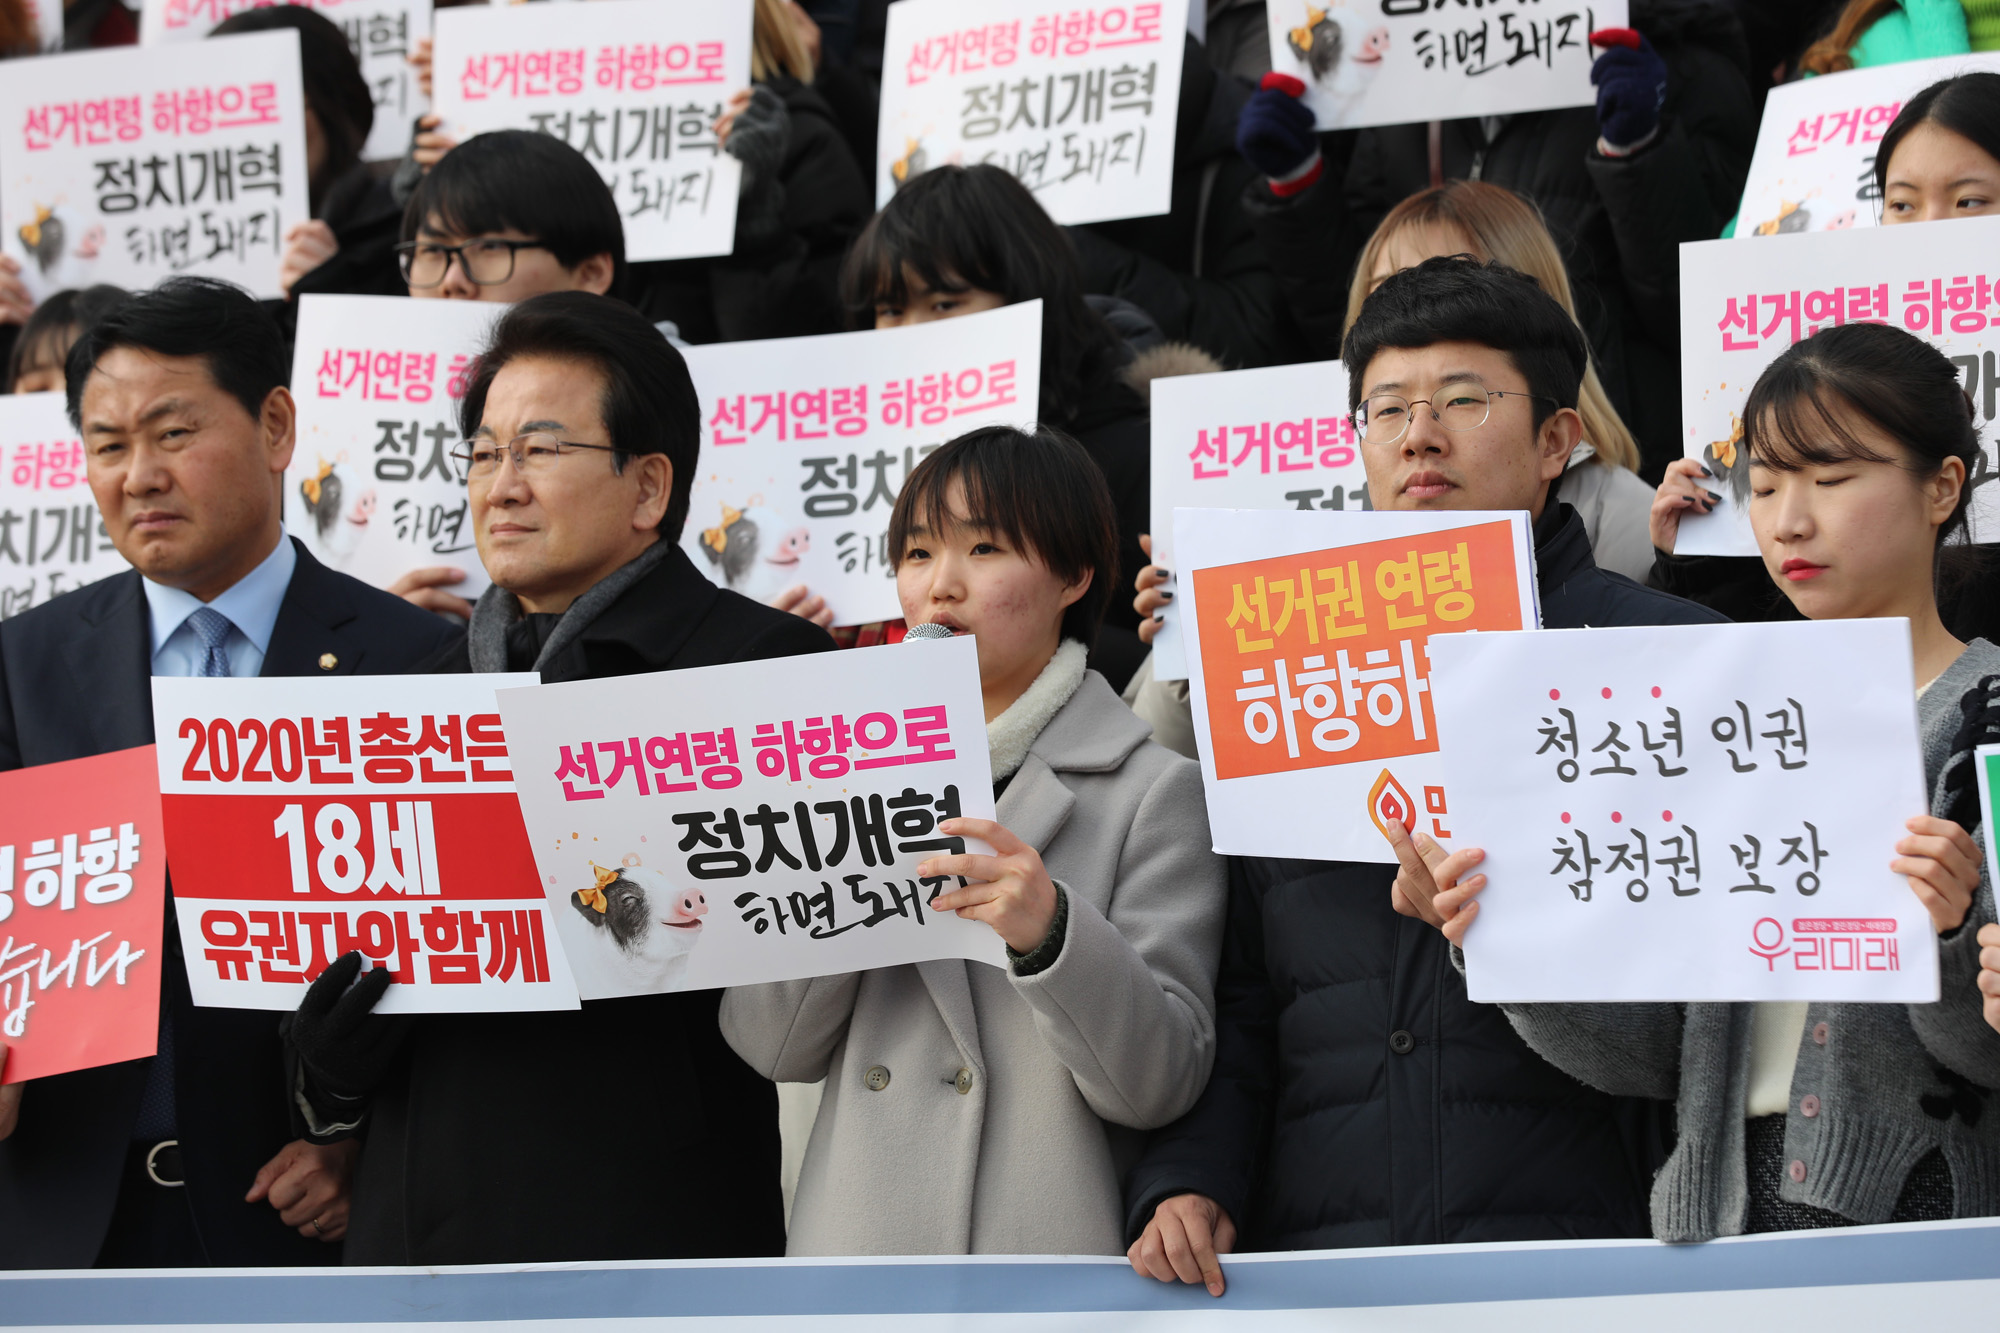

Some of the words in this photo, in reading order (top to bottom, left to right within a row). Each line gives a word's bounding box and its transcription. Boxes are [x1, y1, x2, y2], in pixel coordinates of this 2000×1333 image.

[461, 47, 586, 102] 선거연령
[595, 41, 727, 94] 하향으로
[906, 19, 1021, 86] 선거연령
[1029, 2, 1164, 58] 하향으로
[1413, 19, 1490, 76] 하면
[1500, 8, 1595, 67] 돼지
[22, 97, 142, 151] 선거연령
[152, 82, 282, 138] 하향으로
[961, 61, 1158, 140] 정치개혁
[1787, 101, 1912, 157] 선거연
[94, 142, 282, 214] 정치개혁
[1062, 125, 1146, 184] 돼지
[125, 220, 196, 270] 하면
[199, 209, 281, 263] 돼지
[1718, 283, 1889, 352] 선거연령
[317, 348, 437, 403] 선거연령
[709, 384, 868, 446] 선거연령
[880, 359, 1017, 428] 하향으로
[1189, 413, 1355, 480] 선거연령
[393, 498, 476, 554] 하면
[1226, 560, 1367, 654] 선거권
[1375, 542, 1476, 630] 연령
[1235, 638, 1434, 759] 하향하
[178, 716, 354, 784] 2020년
[359, 712, 515, 784] 총선은
[554, 727, 743, 801] 선거연령
[751, 704, 957, 783] 하향으로
[1535, 706, 1689, 783] 청소년
[1711, 697, 1809, 773] 인권
[23, 822, 140, 910] 하향
[273, 801, 442, 895] 18세
[672, 784, 966, 880] 정치개혁
[1550, 824, 1703, 902] 참정권
[1729, 821, 1829, 896] 보장
[200, 909, 420, 985] 유권자와
[419, 906, 551, 984] 함께
[734, 881, 842, 939] 하면
[1749, 917, 1900, 972] 우리미래
